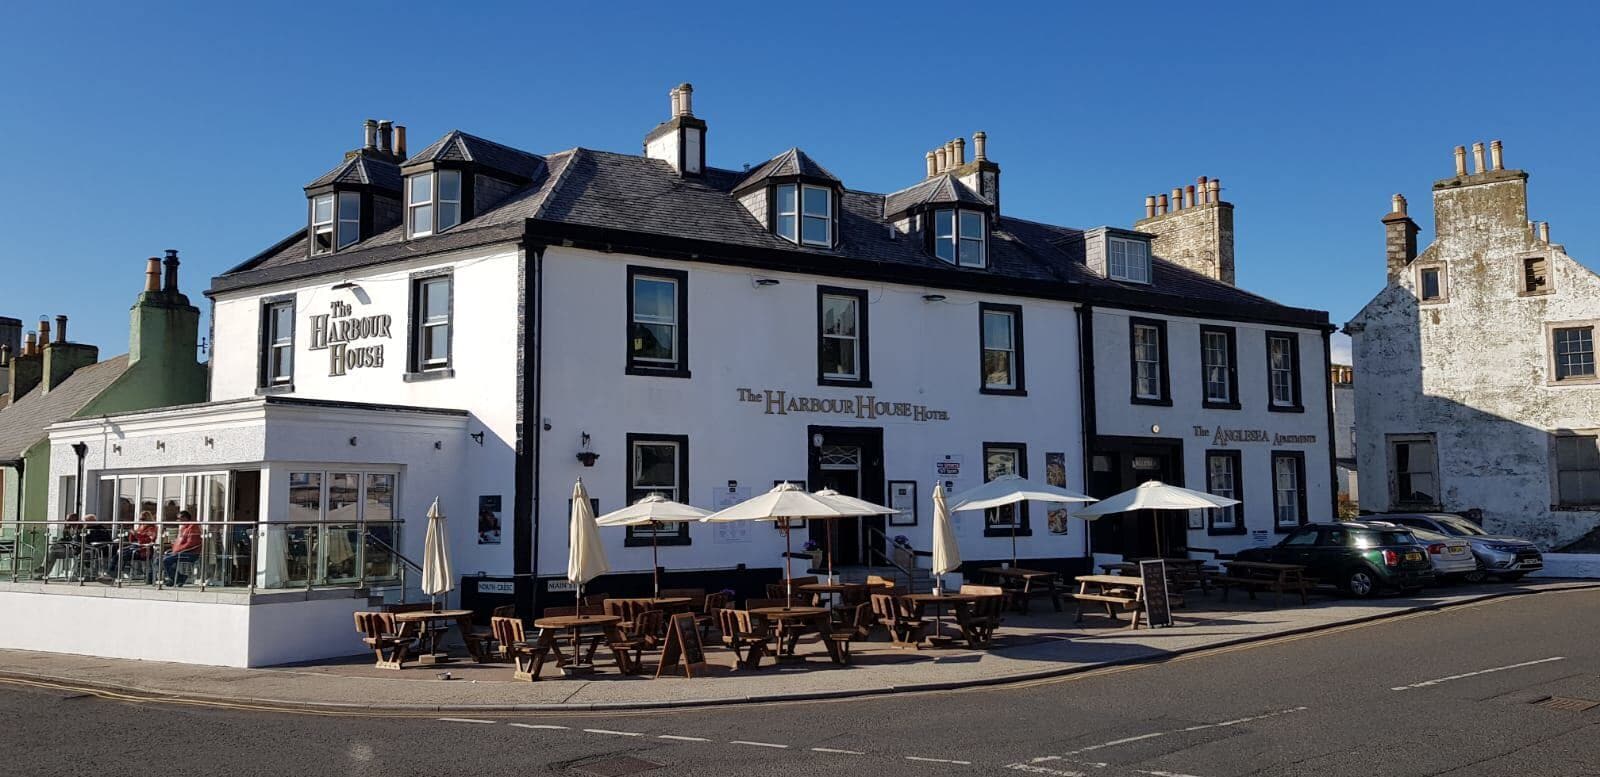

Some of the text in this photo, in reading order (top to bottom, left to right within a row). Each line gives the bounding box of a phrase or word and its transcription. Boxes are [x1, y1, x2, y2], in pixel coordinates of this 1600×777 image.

[330, 300, 352, 318] The
[308, 313, 392, 351] HARBOUR
[328, 343, 384, 377] HOUSE
[736, 388, 949, 421] The HARBOUR HOUSE HOTEL
[1192, 425, 1209, 437] The
[1212, 425, 1270, 446] ANGLESEA
